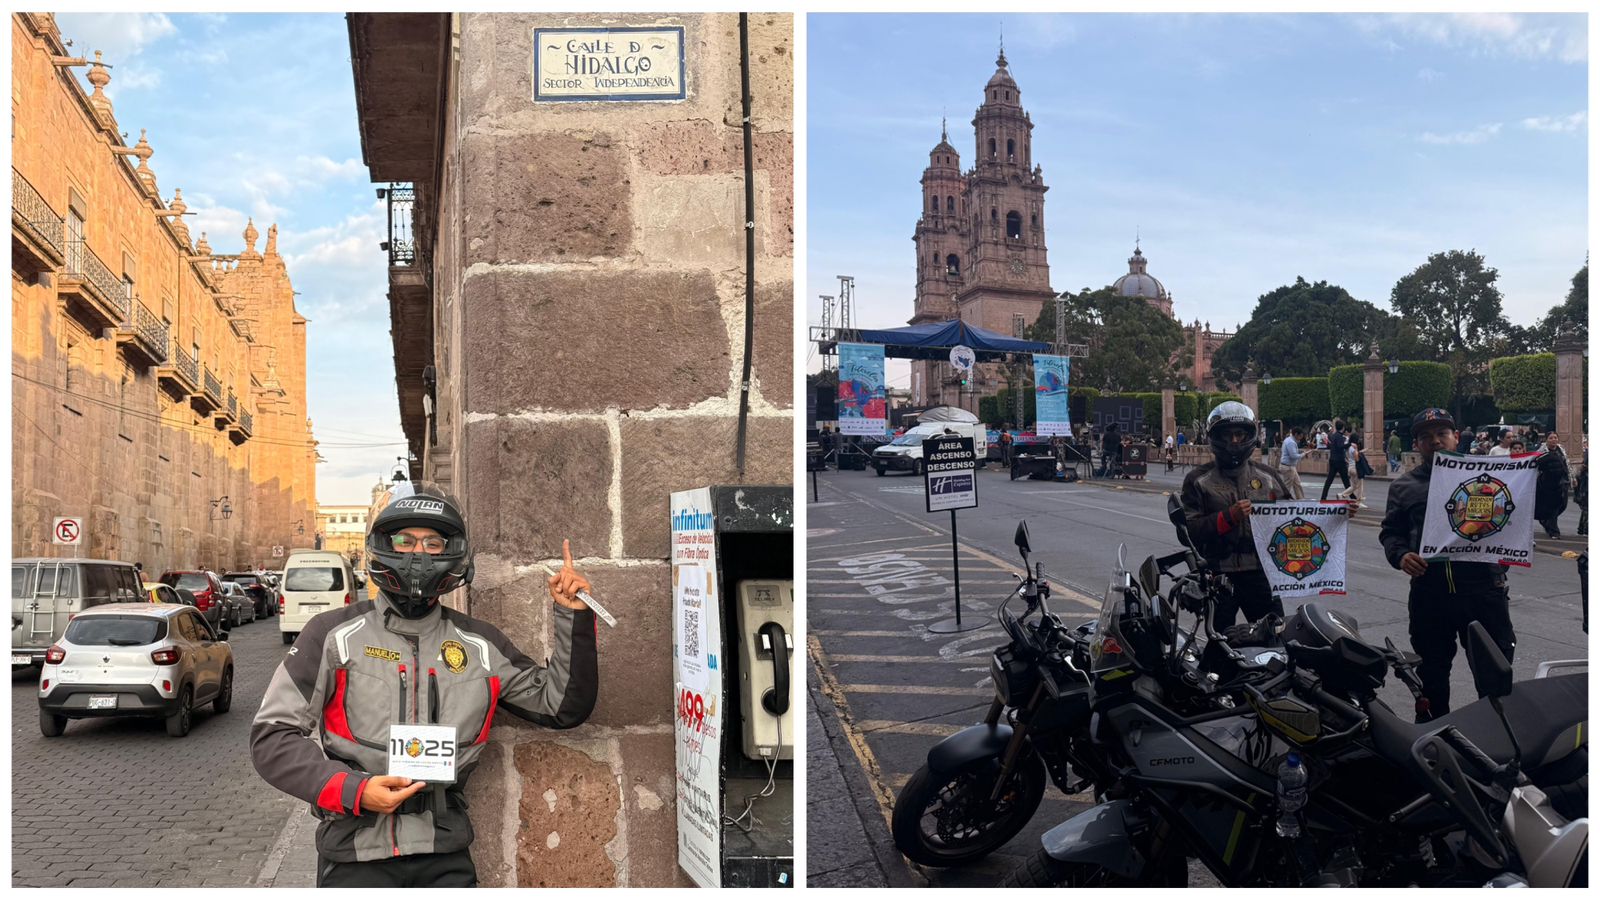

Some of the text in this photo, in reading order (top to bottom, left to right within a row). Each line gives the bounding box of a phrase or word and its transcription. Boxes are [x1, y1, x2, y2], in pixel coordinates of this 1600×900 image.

[564, 54, 652, 76] HIDALGO
[543, 78, 584, 89] SECTOR
[930, 451, 972, 461] ASCENSO
[927, 461, 975, 472] DESCENSO
[1435, 456, 1538, 472] MOTOTURISMO
[396, 500, 444, 513] NOLAN
[1250, 506, 1347, 516] MOTOTURISMO
[673, 508, 713, 531] infinitum
[1440, 543, 1481, 553] ACCIÓN
[1486, 545, 1528, 557] MÉXICO
[1272, 582, 1305, 591] ACCIÓN
[366, 646, 389, 660] MANUEL
[1150, 757, 1195, 767] CFMOTO
